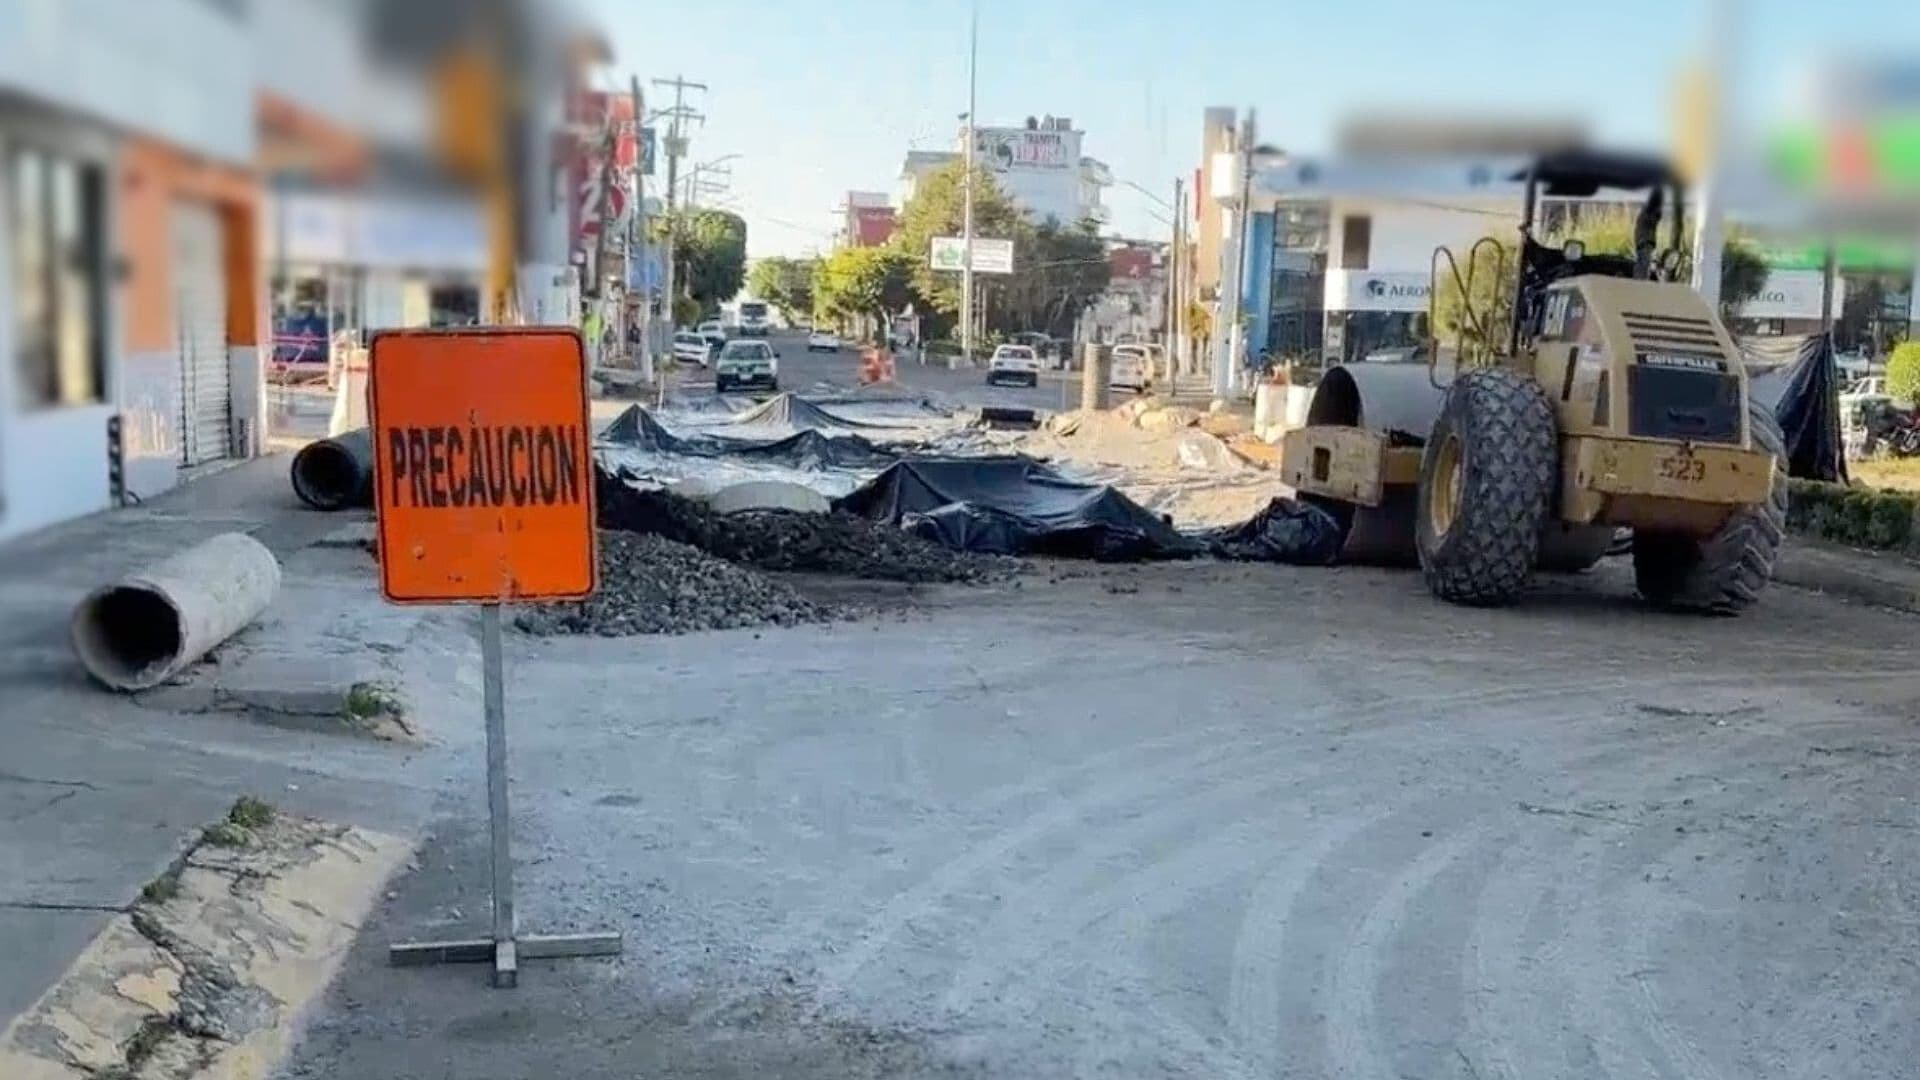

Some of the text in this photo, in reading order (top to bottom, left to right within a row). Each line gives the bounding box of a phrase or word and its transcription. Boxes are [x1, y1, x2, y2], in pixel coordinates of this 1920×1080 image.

[1646, 353, 1719, 371] CATERPILLAR
[388, 425, 580, 507] PRECAUCION
[1659, 456, 1706, 481] 523
